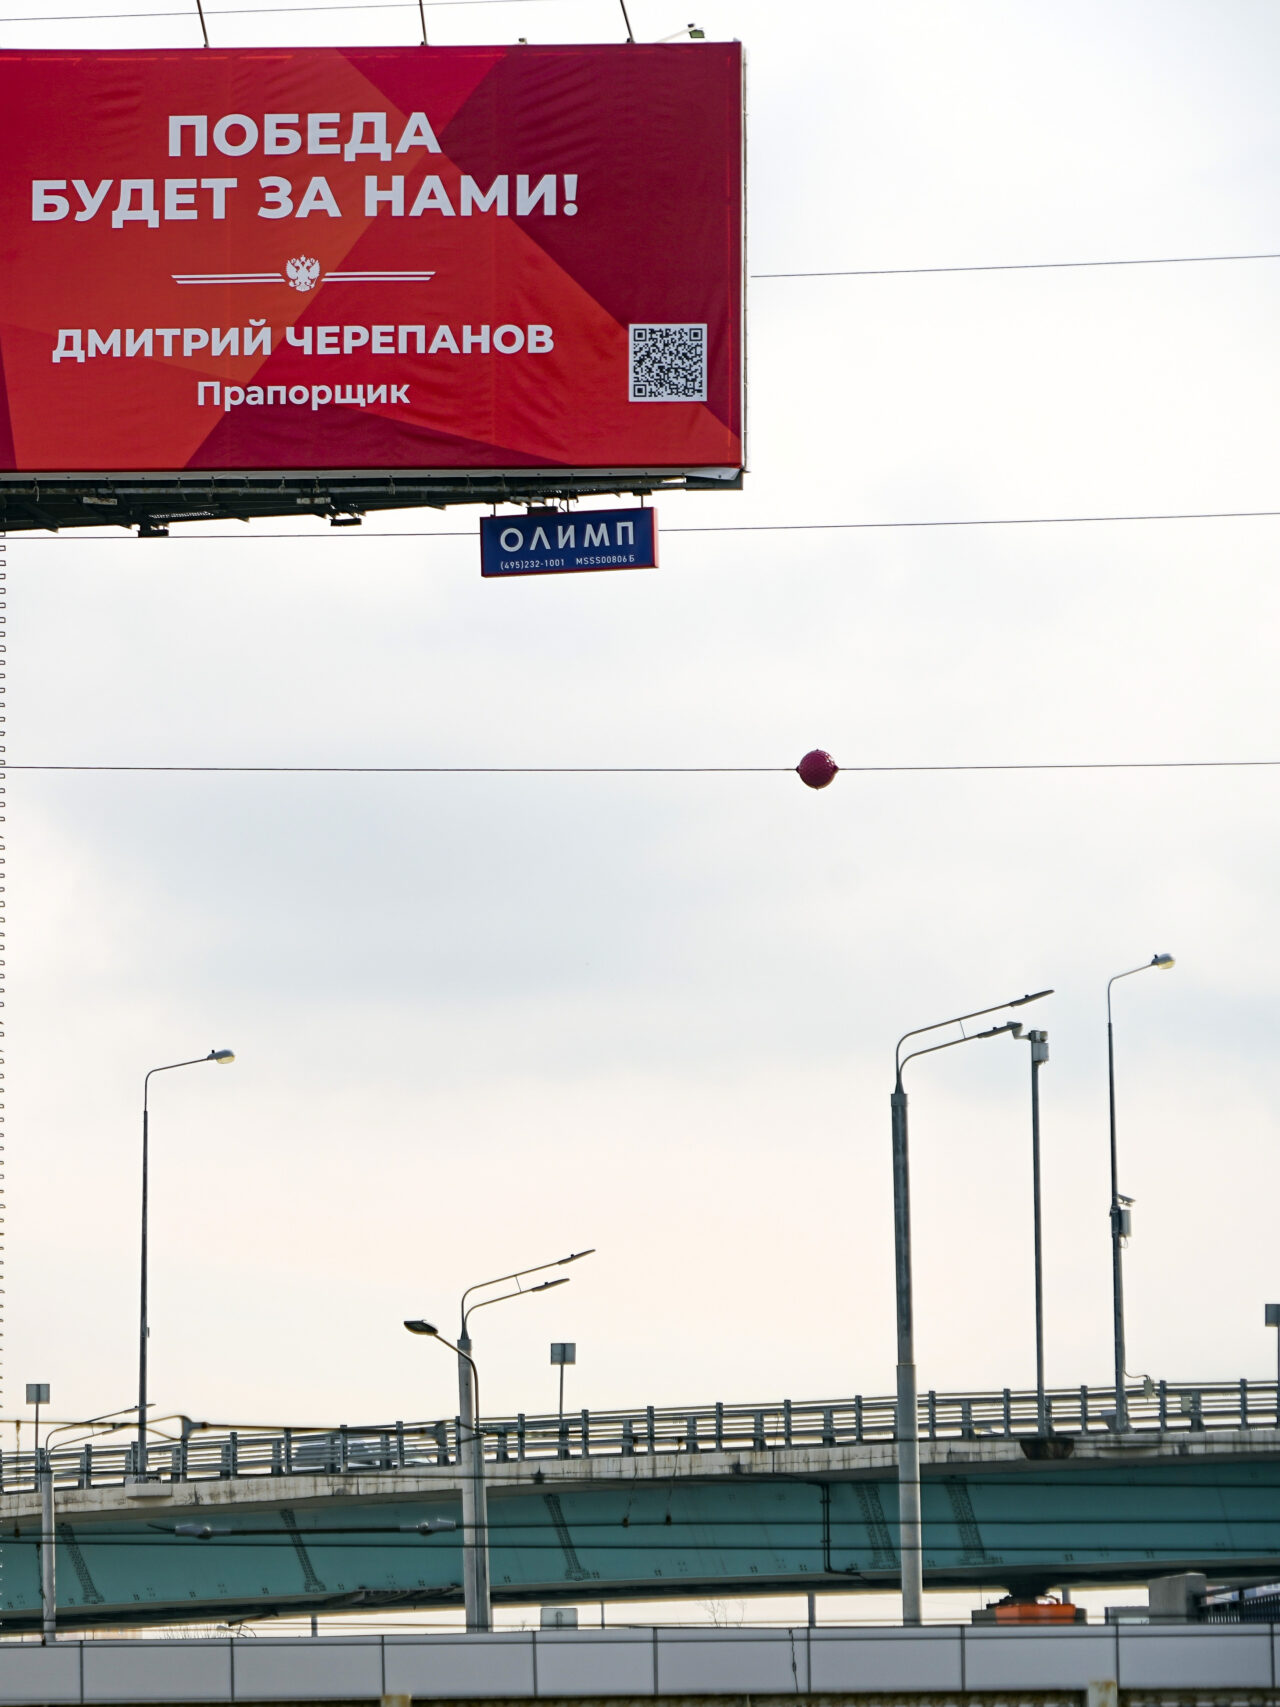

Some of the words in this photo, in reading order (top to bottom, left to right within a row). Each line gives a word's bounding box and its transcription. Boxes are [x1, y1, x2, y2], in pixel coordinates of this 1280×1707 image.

[167, 111, 441, 162] ПОБЕДА
[30, 177, 238, 229] БУДЕТ
[257, 175, 342, 219] ЗА
[364, 173, 580, 219] НАМИ!
[52, 319, 273, 363] ДМИТРИЙ
[285, 323, 555, 356] ЧЕРЕПАНОВ
[196, 380, 411, 411] Прапорщик
[500, 521, 635, 552] ОЛИМП
[500, 558, 565, 570] (495)232-1001
